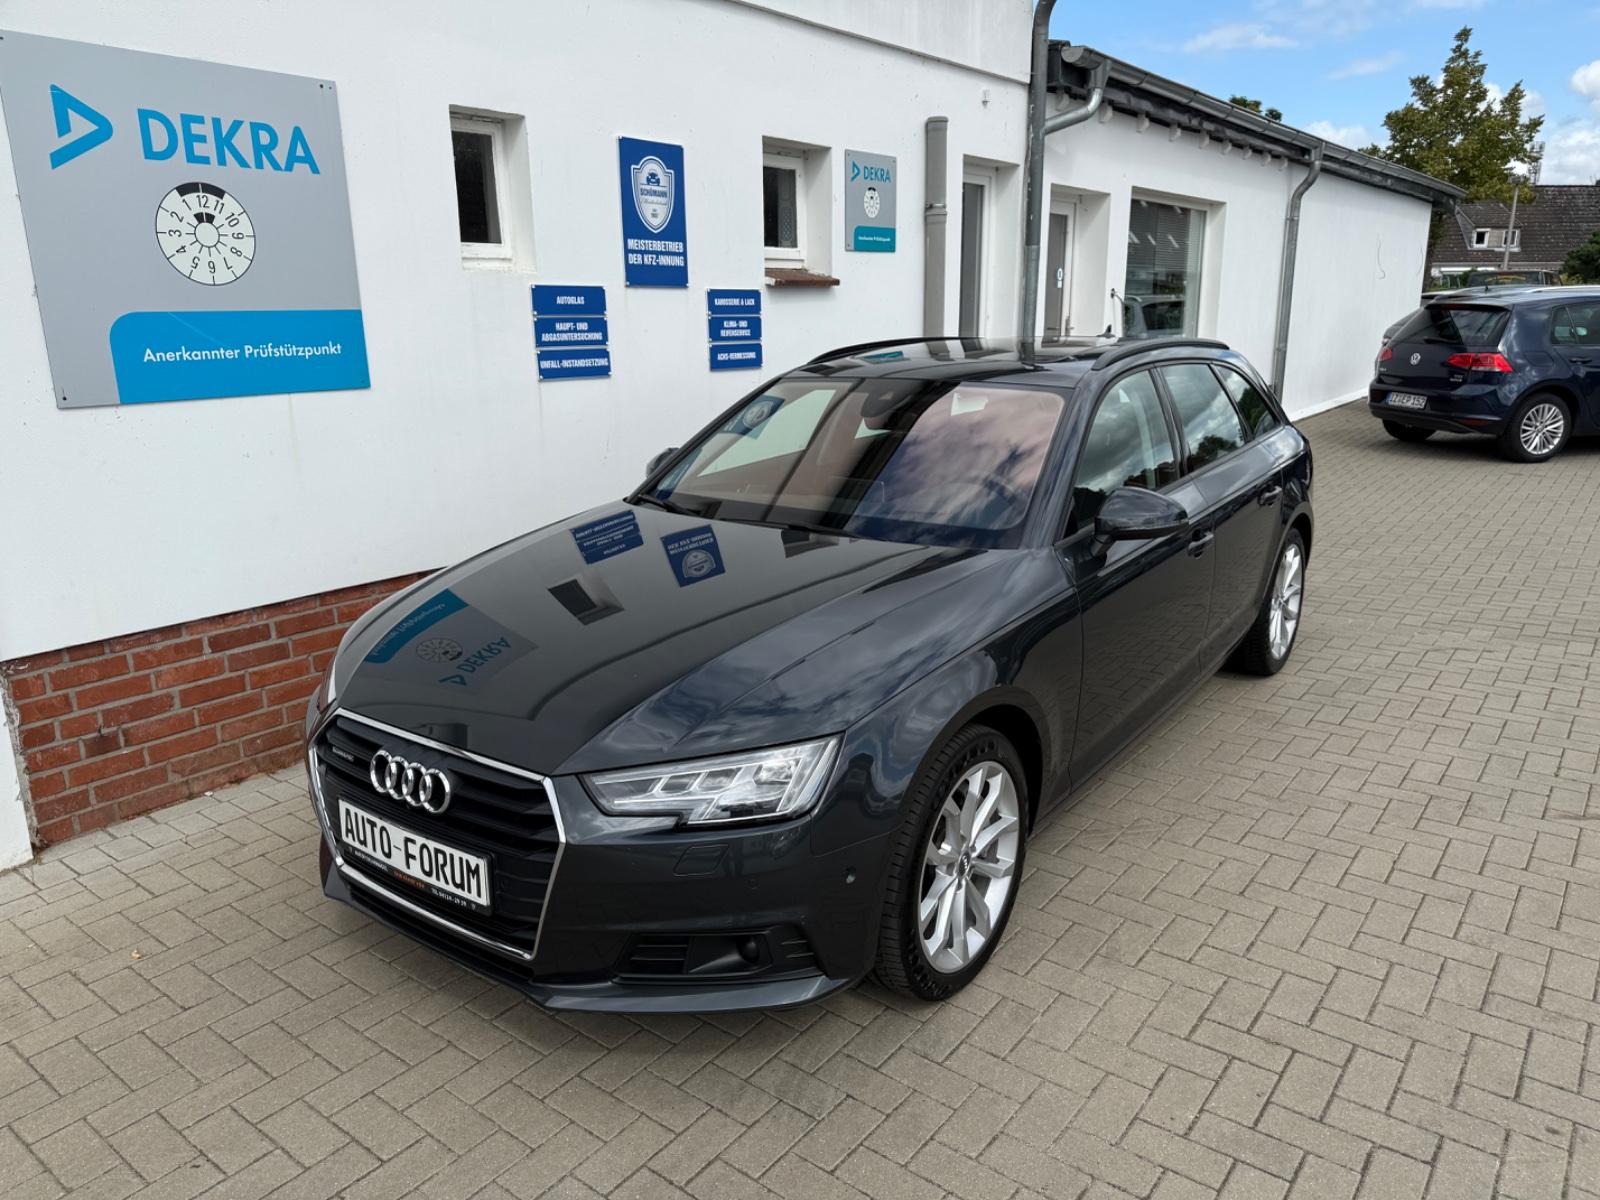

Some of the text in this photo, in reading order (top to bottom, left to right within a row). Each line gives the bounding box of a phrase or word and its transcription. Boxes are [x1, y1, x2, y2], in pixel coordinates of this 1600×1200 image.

[136, 107, 321, 174] DEKRA
[864, 166, 891, 182] DEKRA
[168, 194, 245, 274] 12 11 10 9 8 7 6 5 4 3 2 1
[627, 238, 685, 253] MEISTERBETRIEB
[628, 253, 685, 267] DER KFZ-INNUNG
[557, 296, 585, 305] AUTOGLAS
[745, 298, 755, 306] LACK
[555, 321, 588, 331] HAUPT- UND
[723, 320, 748, 328] KLIMA- UND
[541, 332, 603, 342] ABGASUNTERSUCHUNG
[144, 341, 342, 363] Anerkannter Prüfstützpunkt
[717, 351, 756, 361] ACHS-VERMESSUNG
[540, 358, 609, 369] UNFALL-INSTANDSETZUNG
[345, 807, 482, 899] AUTO-FORUM
